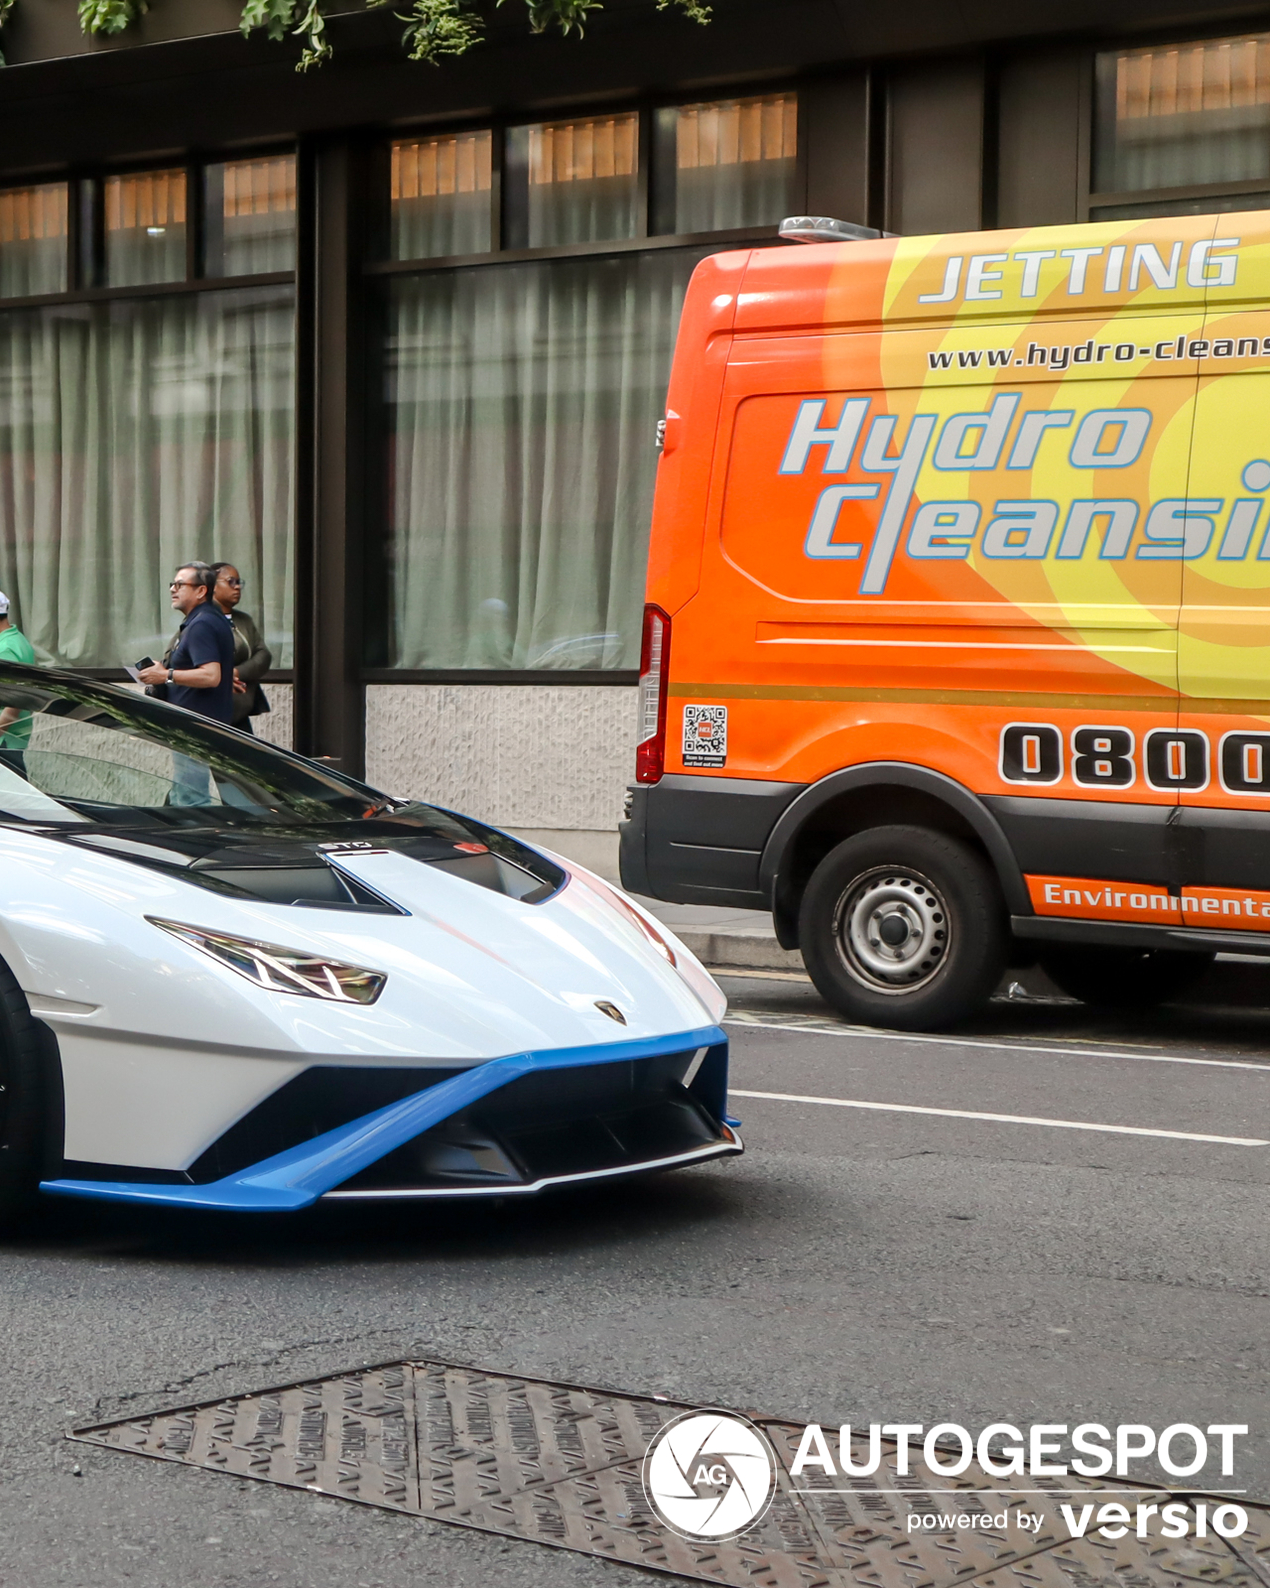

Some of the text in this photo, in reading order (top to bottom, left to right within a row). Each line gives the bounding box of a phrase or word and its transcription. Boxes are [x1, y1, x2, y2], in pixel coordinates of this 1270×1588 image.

[918, 237, 1241, 304] JETTING
[778, 392, 1153, 502] Hydro
[804, 459, 1270, 594] Cleansi
[998, 722, 1270, 797] 0800
[1044, 884, 1270, 918] Environmenta
